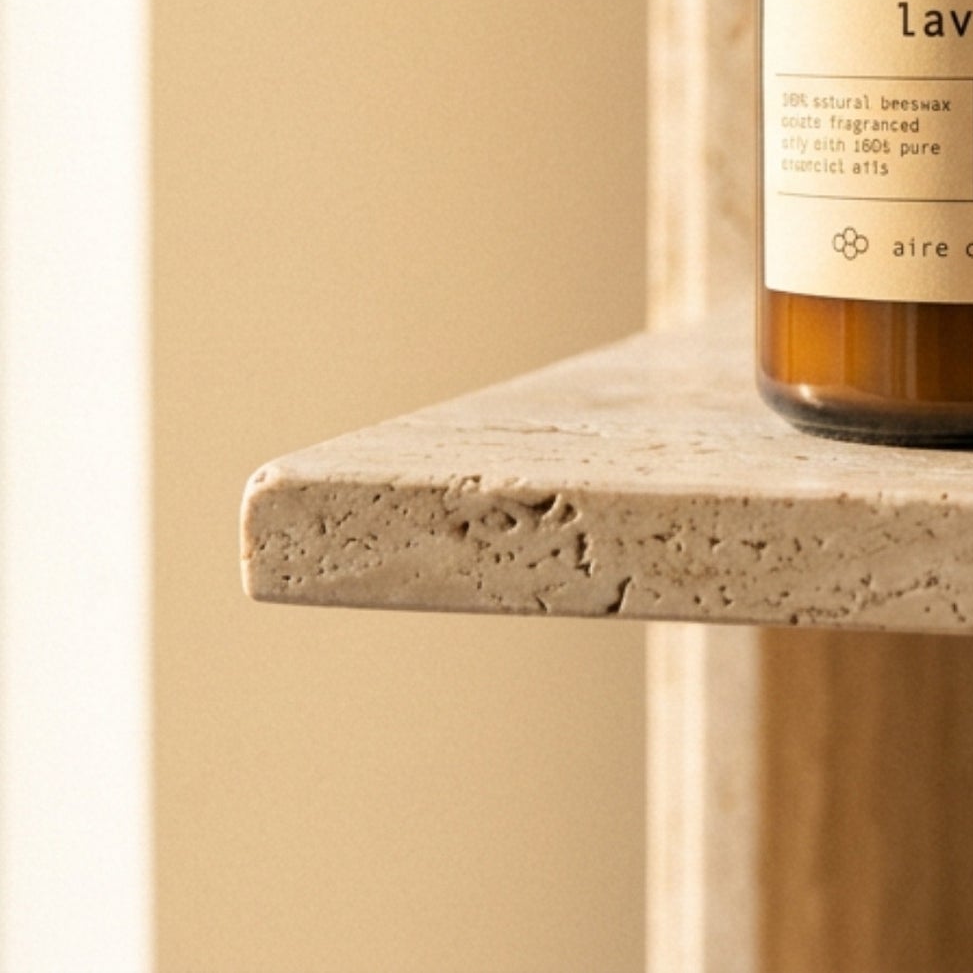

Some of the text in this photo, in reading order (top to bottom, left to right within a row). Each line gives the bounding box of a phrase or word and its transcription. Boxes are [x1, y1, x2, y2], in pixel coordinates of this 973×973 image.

[898, 2, 973, 37] lav
[830, 115, 920, 135] fragranced
[900, 142, 942, 157] pure
[892, 236, 949, 258] aire
